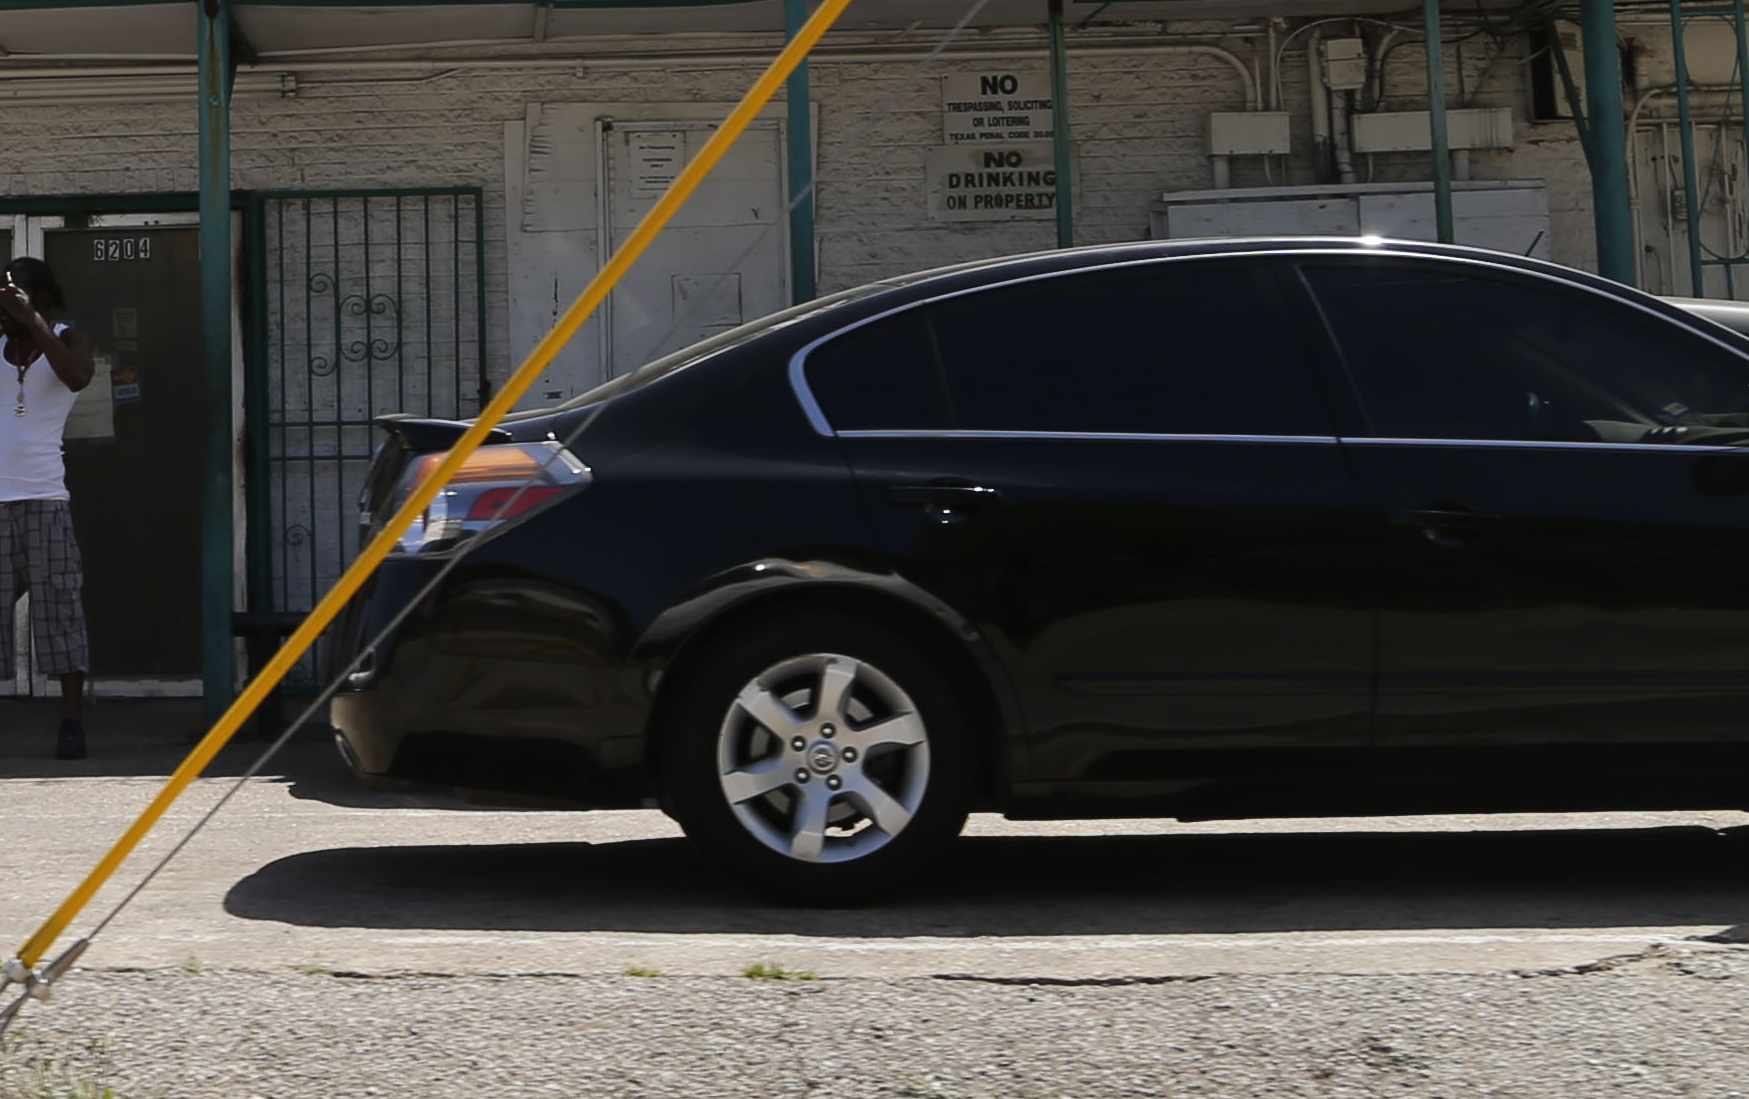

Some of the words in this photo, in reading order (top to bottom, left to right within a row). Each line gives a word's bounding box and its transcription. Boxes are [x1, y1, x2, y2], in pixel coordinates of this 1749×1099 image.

[981, 75, 1018, 95] NO
[973, 117, 984, 127] OR
[988, 116, 1030, 127] LOITERING
[950, 132, 976, 140] TEXAS
[1008, 131, 1030, 139] CODE
[983, 151, 1022, 168] NO
[949, 171, 1056, 188] DRINKING
[947, 195, 967, 210] ON
[974, 192, 1056, 209] PROPERTY
[94, 239, 150, 260] 6204
[116, 385, 139, 397] VISA
